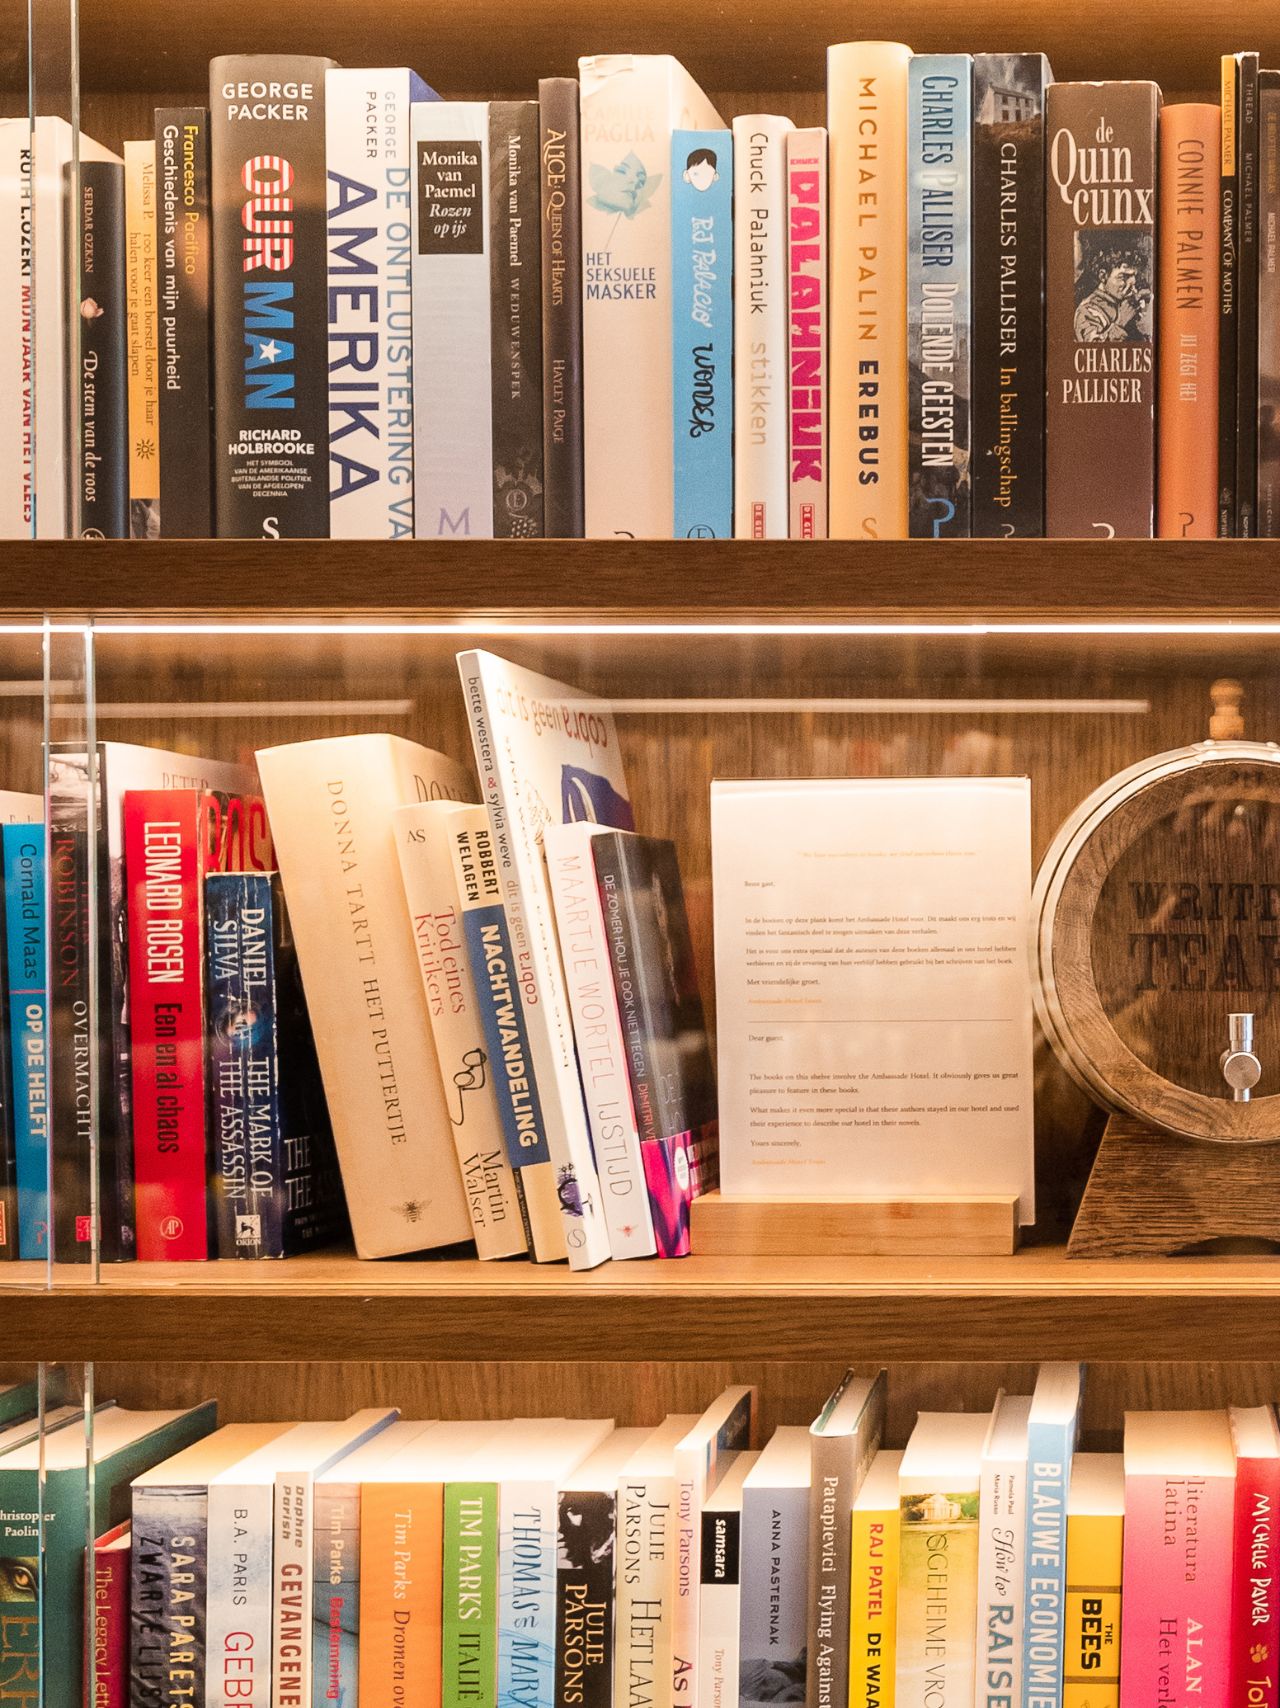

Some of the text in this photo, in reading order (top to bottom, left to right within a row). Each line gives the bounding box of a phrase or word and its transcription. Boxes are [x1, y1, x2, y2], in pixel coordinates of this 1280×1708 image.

[222, 82, 314, 100] GEORGE
[227, 104, 309, 121] PACKER
[366, 91, 378, 159] PACKER
[384, 91, 396, 159] GEORGE
[422, 151, 478, 167] Monika
[1051, 127, 1133, 203] Quin
[1096, 119, 1113, 143] de
[184, 124, 198, 275] Francesco Pacifico
[425, 184, 476, 198] Paemel
[437, 169, 462, 182] van
[1073, 186, 1153, 225] cunx
[428, 203, 471, 218] Rozen
[433, 219, 466, 237] op ijs
[163, 124, 179, 390] Geschiedenis van mijn puurheid
[240, 155, 295, 409] OUR MAN
[749, 133, 768, 445] Chuck Palahniuk stikken
[858, 77, 879, 486] MICHAEL PALIN EREBUS
[327, 170, 380, 501] AMERIKA
[1074, 348, 1152, 373] CHARLES
[1062, 378, 1142, 403] PALLISER
[229, 443, 315, 455] HOLBROOKE
[240, 430, 301, 441] RICHARD
[456, 832, 478, 901] WELAGEN
[474, 830, 499, 895] ROBBERT
[143, 821, 184, 984] LEONARD ROSEN
[214, 920, 236, 980] SILVA
[241, 908, 266, 989] DANIEL
[480, 924, 538, 1148] NACHTWANDELING
[219, 1060, 246, 1199] THE ASSASSIN
[247, 1056, 272, 1198] THE MARK OF
[460, 1497, 483, 1537] TIM
[1031, 1462, 1062, 1567] BLAUWE
[1165, 1481, 1185, 1546] latina
[1185, 1480, 1206, 1583] literatura
[171, 1537, 195, 1605] SARA
[233, 1509, 248, 1606] B.A. PARIS
[458, 1544, 482, 1619] PARKS
[714, 1519, 726, 1578] samsara
[769, 1510, 781, 1645] ANNA PASTERNAK
[1251, 1493, 1272, 1626] MICHELLE PAVER
[867, 1523, 883, 1657] RAJ PATEL DE
[563, 1584, 588, 1704] PARSONS
[585, 1601, 606, 1665] JULIE
[1081, 1599, 1101, 1670] BEES
[1104, 1623, 1112, 1645] THE
[1159, 1618, 1177, 1656] Het
[1185, 1618, 1202, 1693] ALAN
